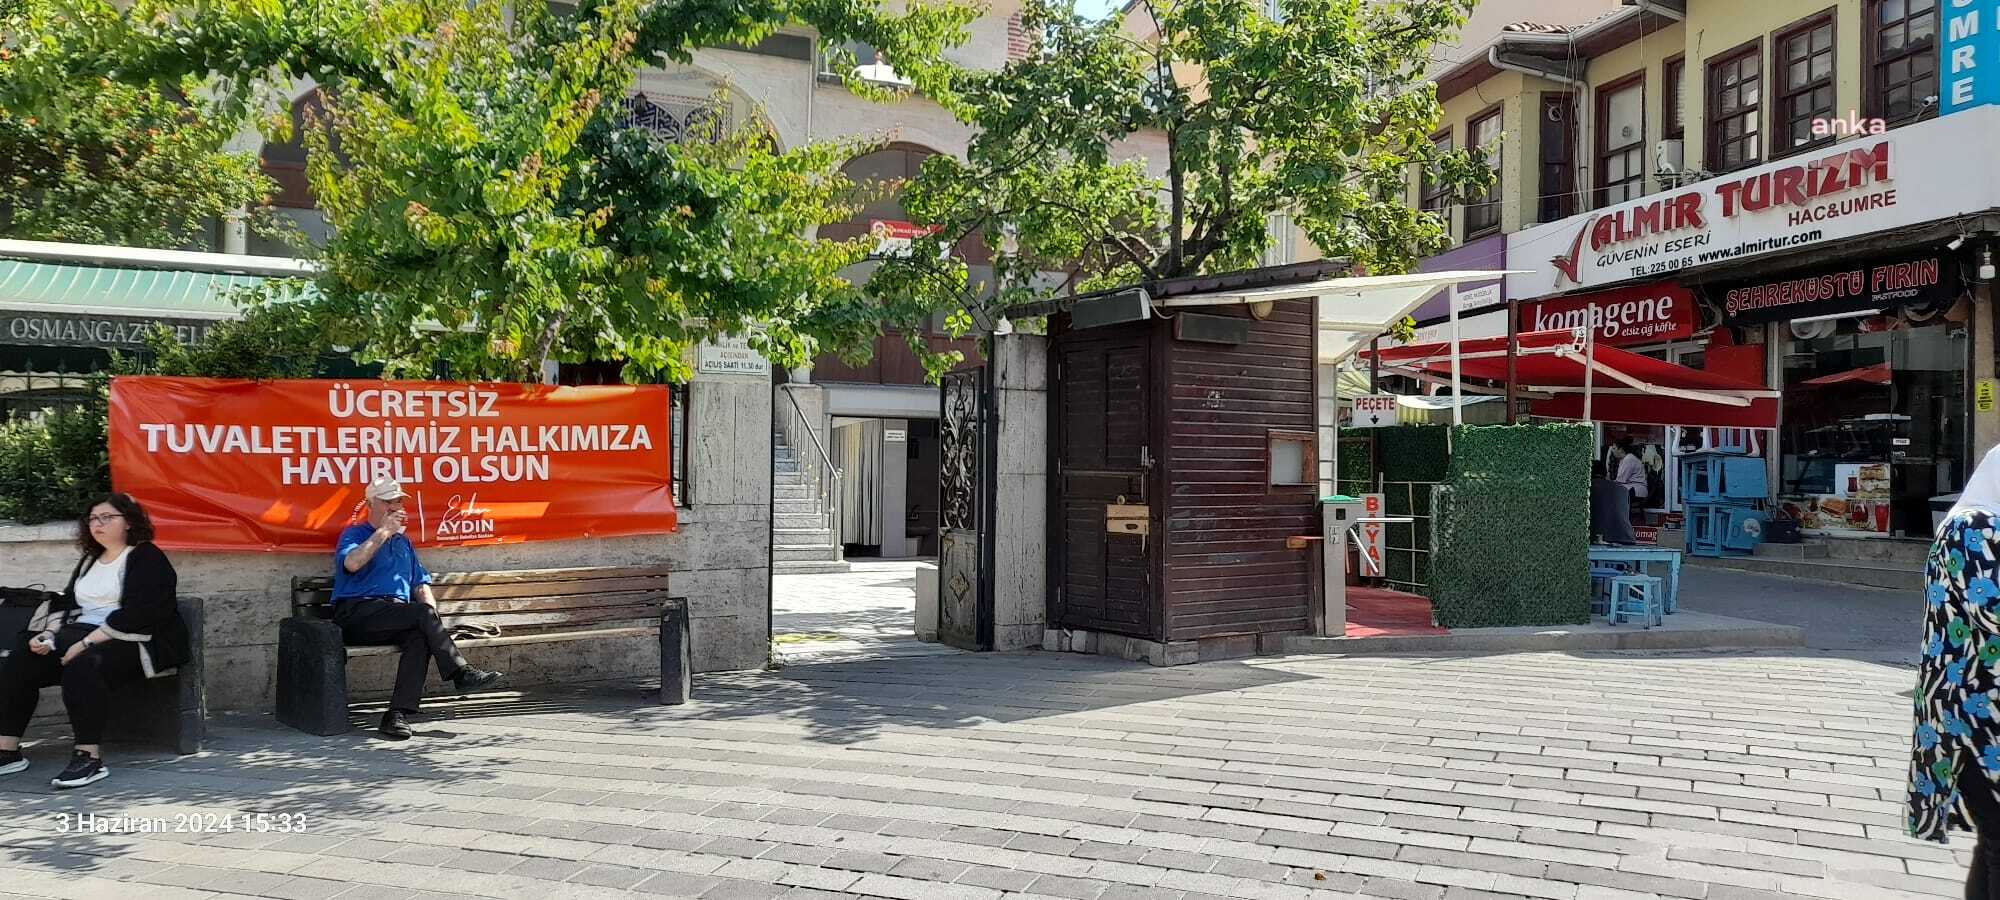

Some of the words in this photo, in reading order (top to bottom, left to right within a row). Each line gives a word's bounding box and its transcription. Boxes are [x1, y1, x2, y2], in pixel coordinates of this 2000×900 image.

[1950, 0, 1979, 105] MRE
[1788, 189, 1897, 227] HAC&UMRE
[1596, 242, 1659, 268] GÜVENİN
[1664, 229, 1712, 254] ESERİ
[1630, 261, 1666, 277] TEL:225
[1668, 258, 1679, 270] 00
[1682, 256, 1693, 267] 65
[1698, 228, 1823, 263] www.almirtur.com
[1726, 269, 1864, 318] ŞEHREKÜSTÜ
[1871, 257, 1939, 293] FIRIN
[1535, 295, 1673, 338] komagene
[1621, 326, 1640, 336] etsiz
[1654, 321, 1677, 333] köfte
[328, 382, 500, 418] ÜCRETSİZ
[1355, 396, 1396, 414] PEÇETE
[139, 420, 461, 455] TUVALETLERİMİZ
[471, 424, 653, 453] HALKIMIZA
[281, 456, 424, 485] HAYIRLI
[432, 454, 549, 483] OLSUN
[436, 518, 495, 535] AYDIN
